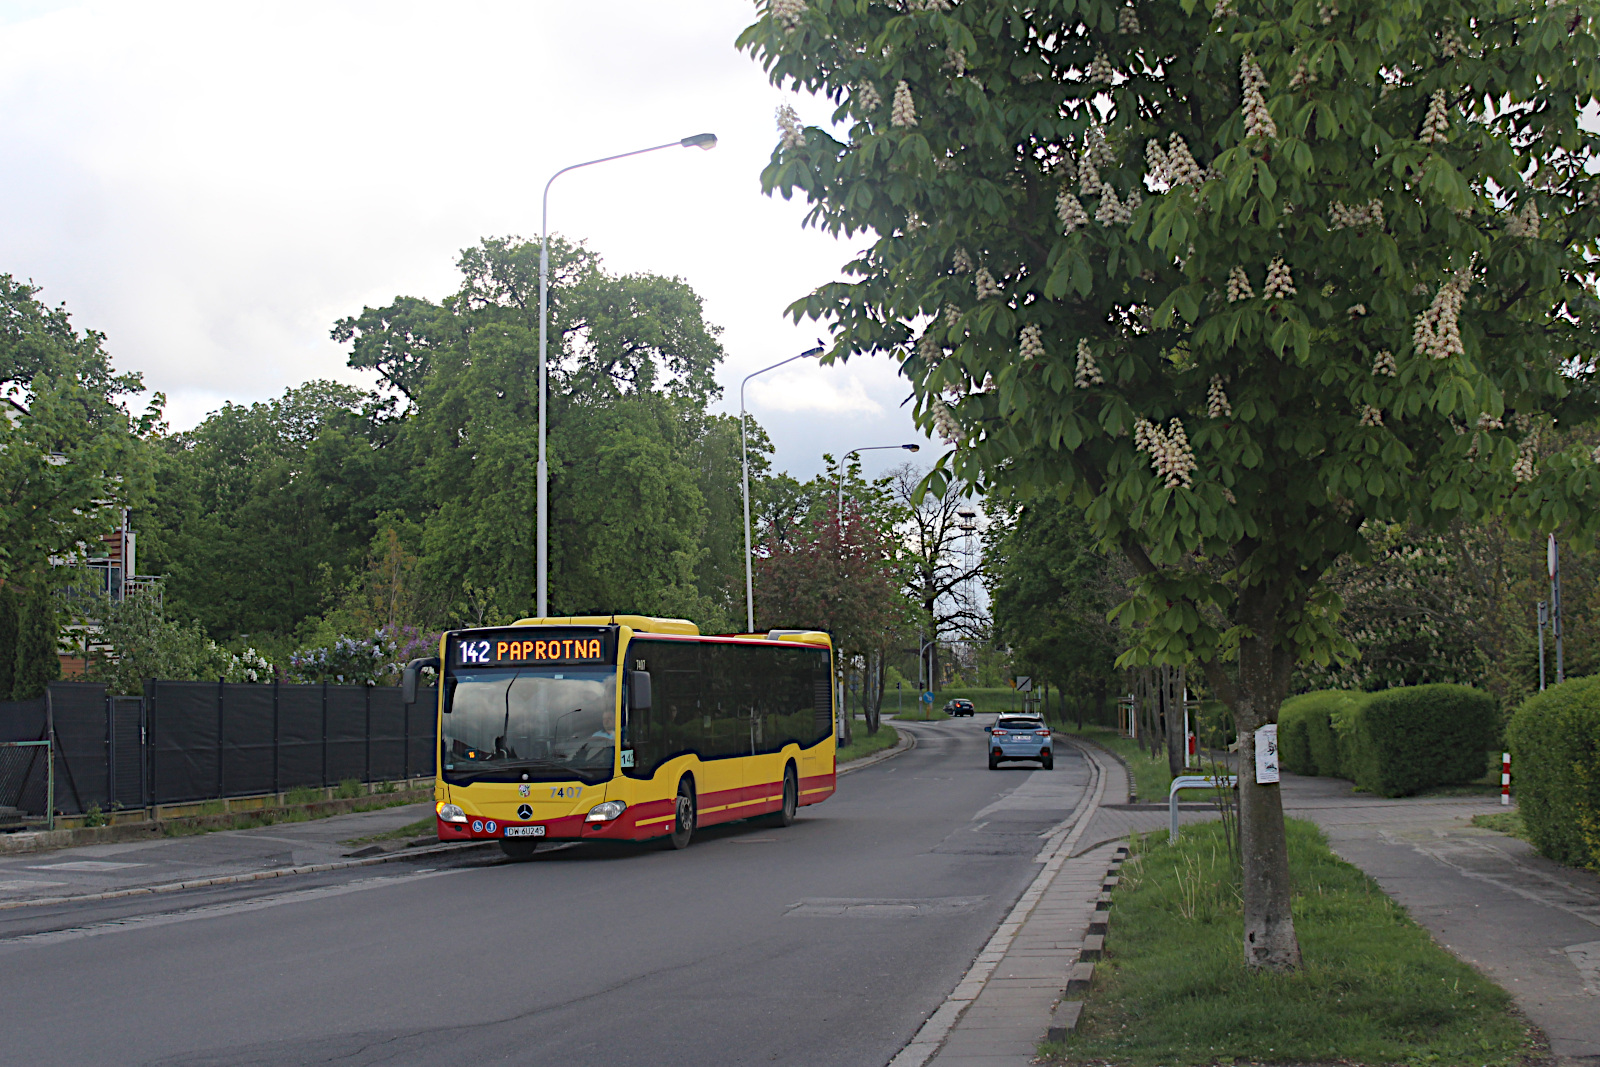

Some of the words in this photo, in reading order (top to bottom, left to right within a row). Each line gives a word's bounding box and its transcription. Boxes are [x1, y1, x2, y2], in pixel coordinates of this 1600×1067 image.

[459, 641, 490, 663] 142
[497, 639, 601, 661] PAPROTNA
[549, 786, 583, 798] 7407
[508, 827, 519, 836] DW
[521, 826, 544, 835] 6U245
